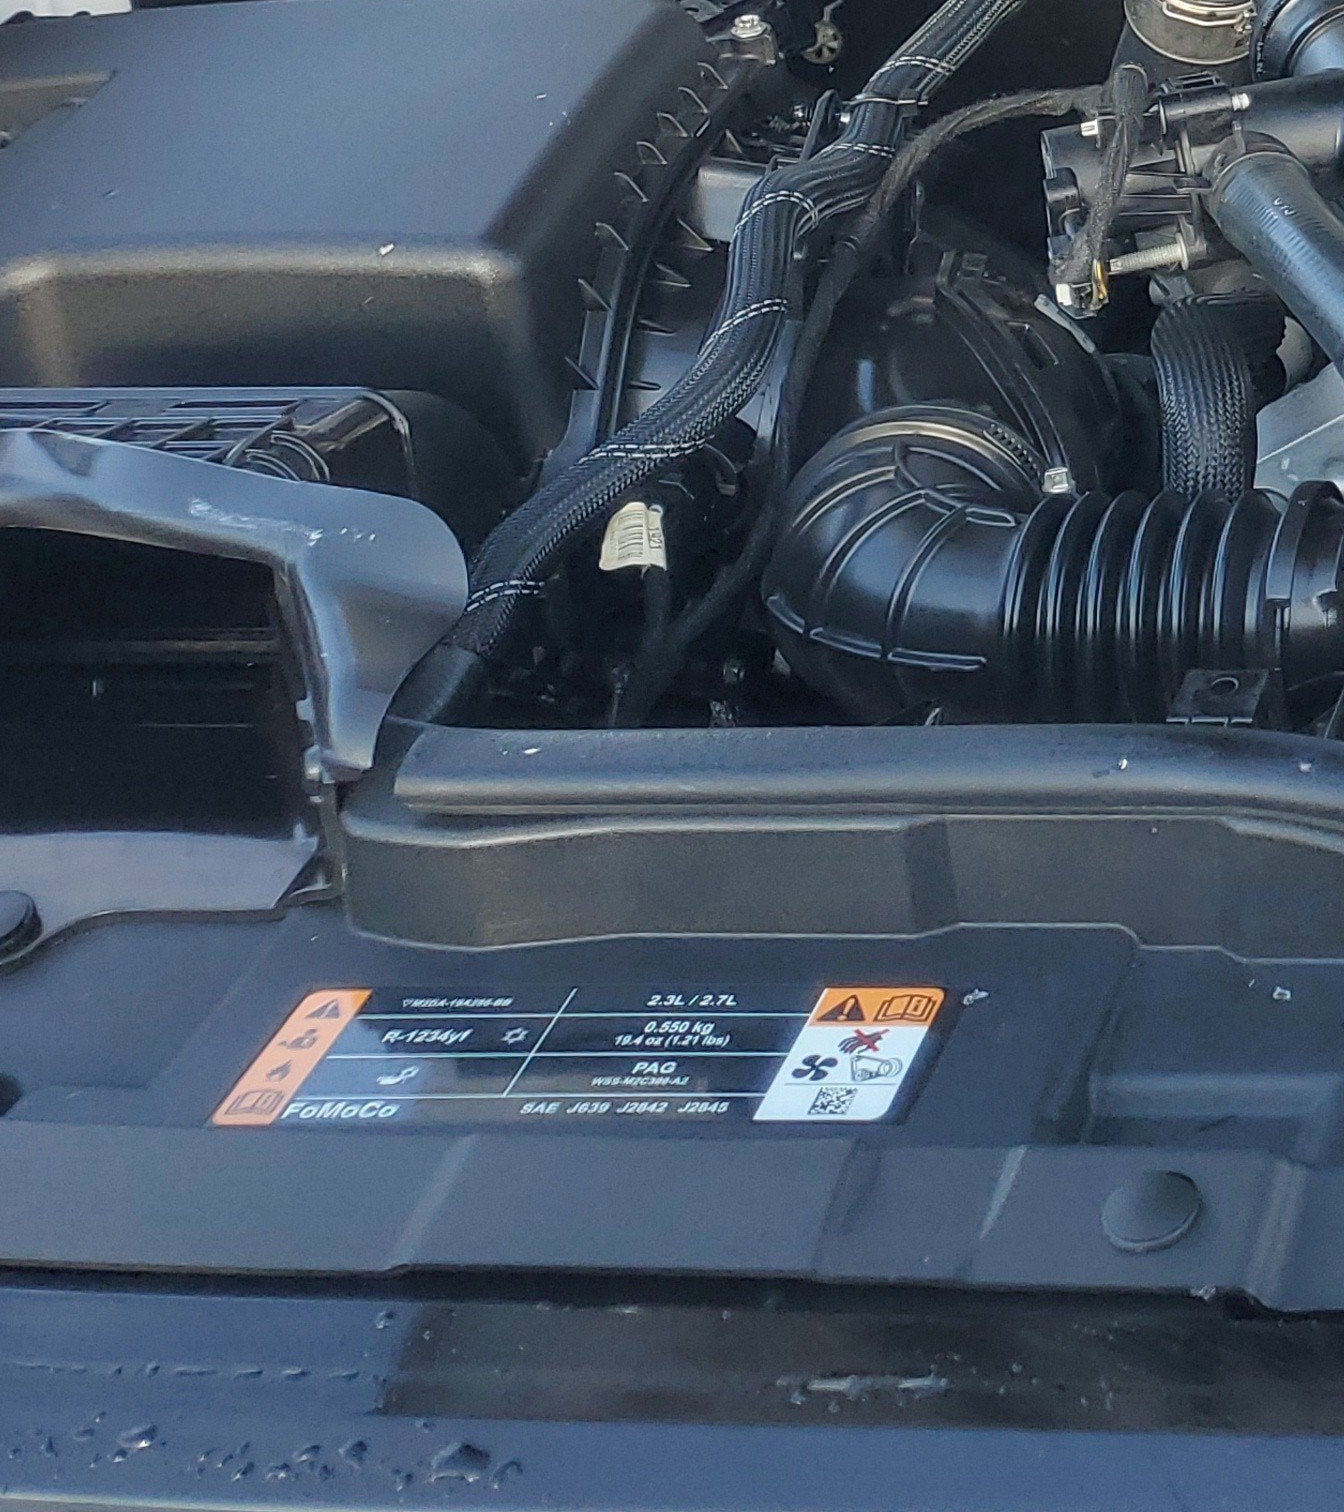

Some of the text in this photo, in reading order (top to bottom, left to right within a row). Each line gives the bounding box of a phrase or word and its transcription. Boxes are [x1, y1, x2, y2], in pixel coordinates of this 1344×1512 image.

[646, 994, 738, 1006] 2.3L / 2.7L
[644, 1021, 716, 1036] 0.550 kg
[381, 1028, 474, 1046] R-1234yf
[645, 1037, 664, 1046] oz
[664, 1035, 701, 1048] (1.21
[701, 1035, 731, 1048] lbs)
[631, 1061, 678, 1075] PAG
[280, 1101, 401, 1120] FoMoCo
[520, 1101, 561, 1114] SAE
